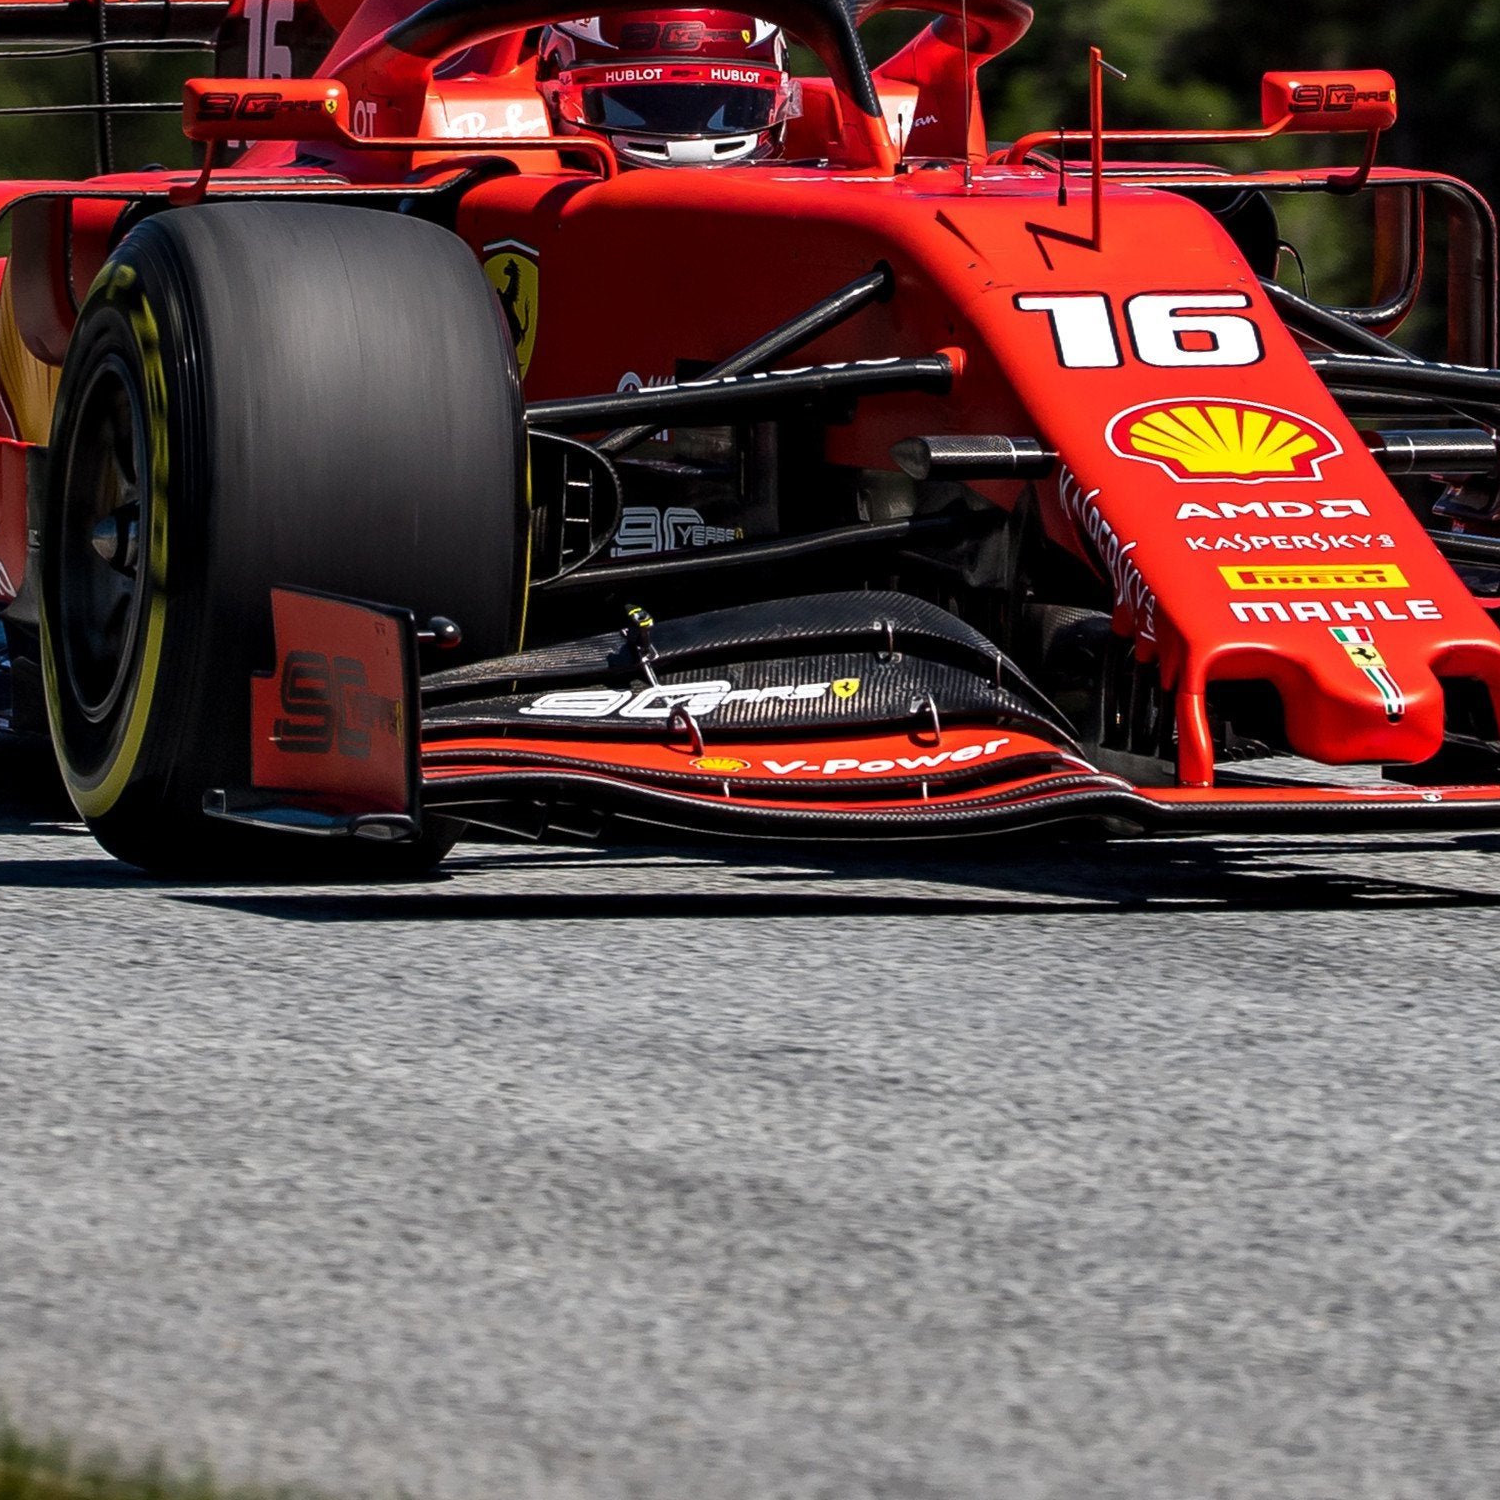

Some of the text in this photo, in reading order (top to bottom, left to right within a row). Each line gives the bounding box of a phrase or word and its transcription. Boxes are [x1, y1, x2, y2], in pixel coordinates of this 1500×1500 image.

[605, 68, 664, 83] HUBLOT
[711, 68, 761, 84] HUBLOT
[1012, 289, 1266, 370] 16
[1175, 500, 1315, 520] AMD
[1184, 531, 1373, 552] KASPERSKY
[1237, 570, 1388, 585] PIRELLI
[1229, 599, 1444, 622] MAHLE
[762, 738, 1010, 775] V-Power
